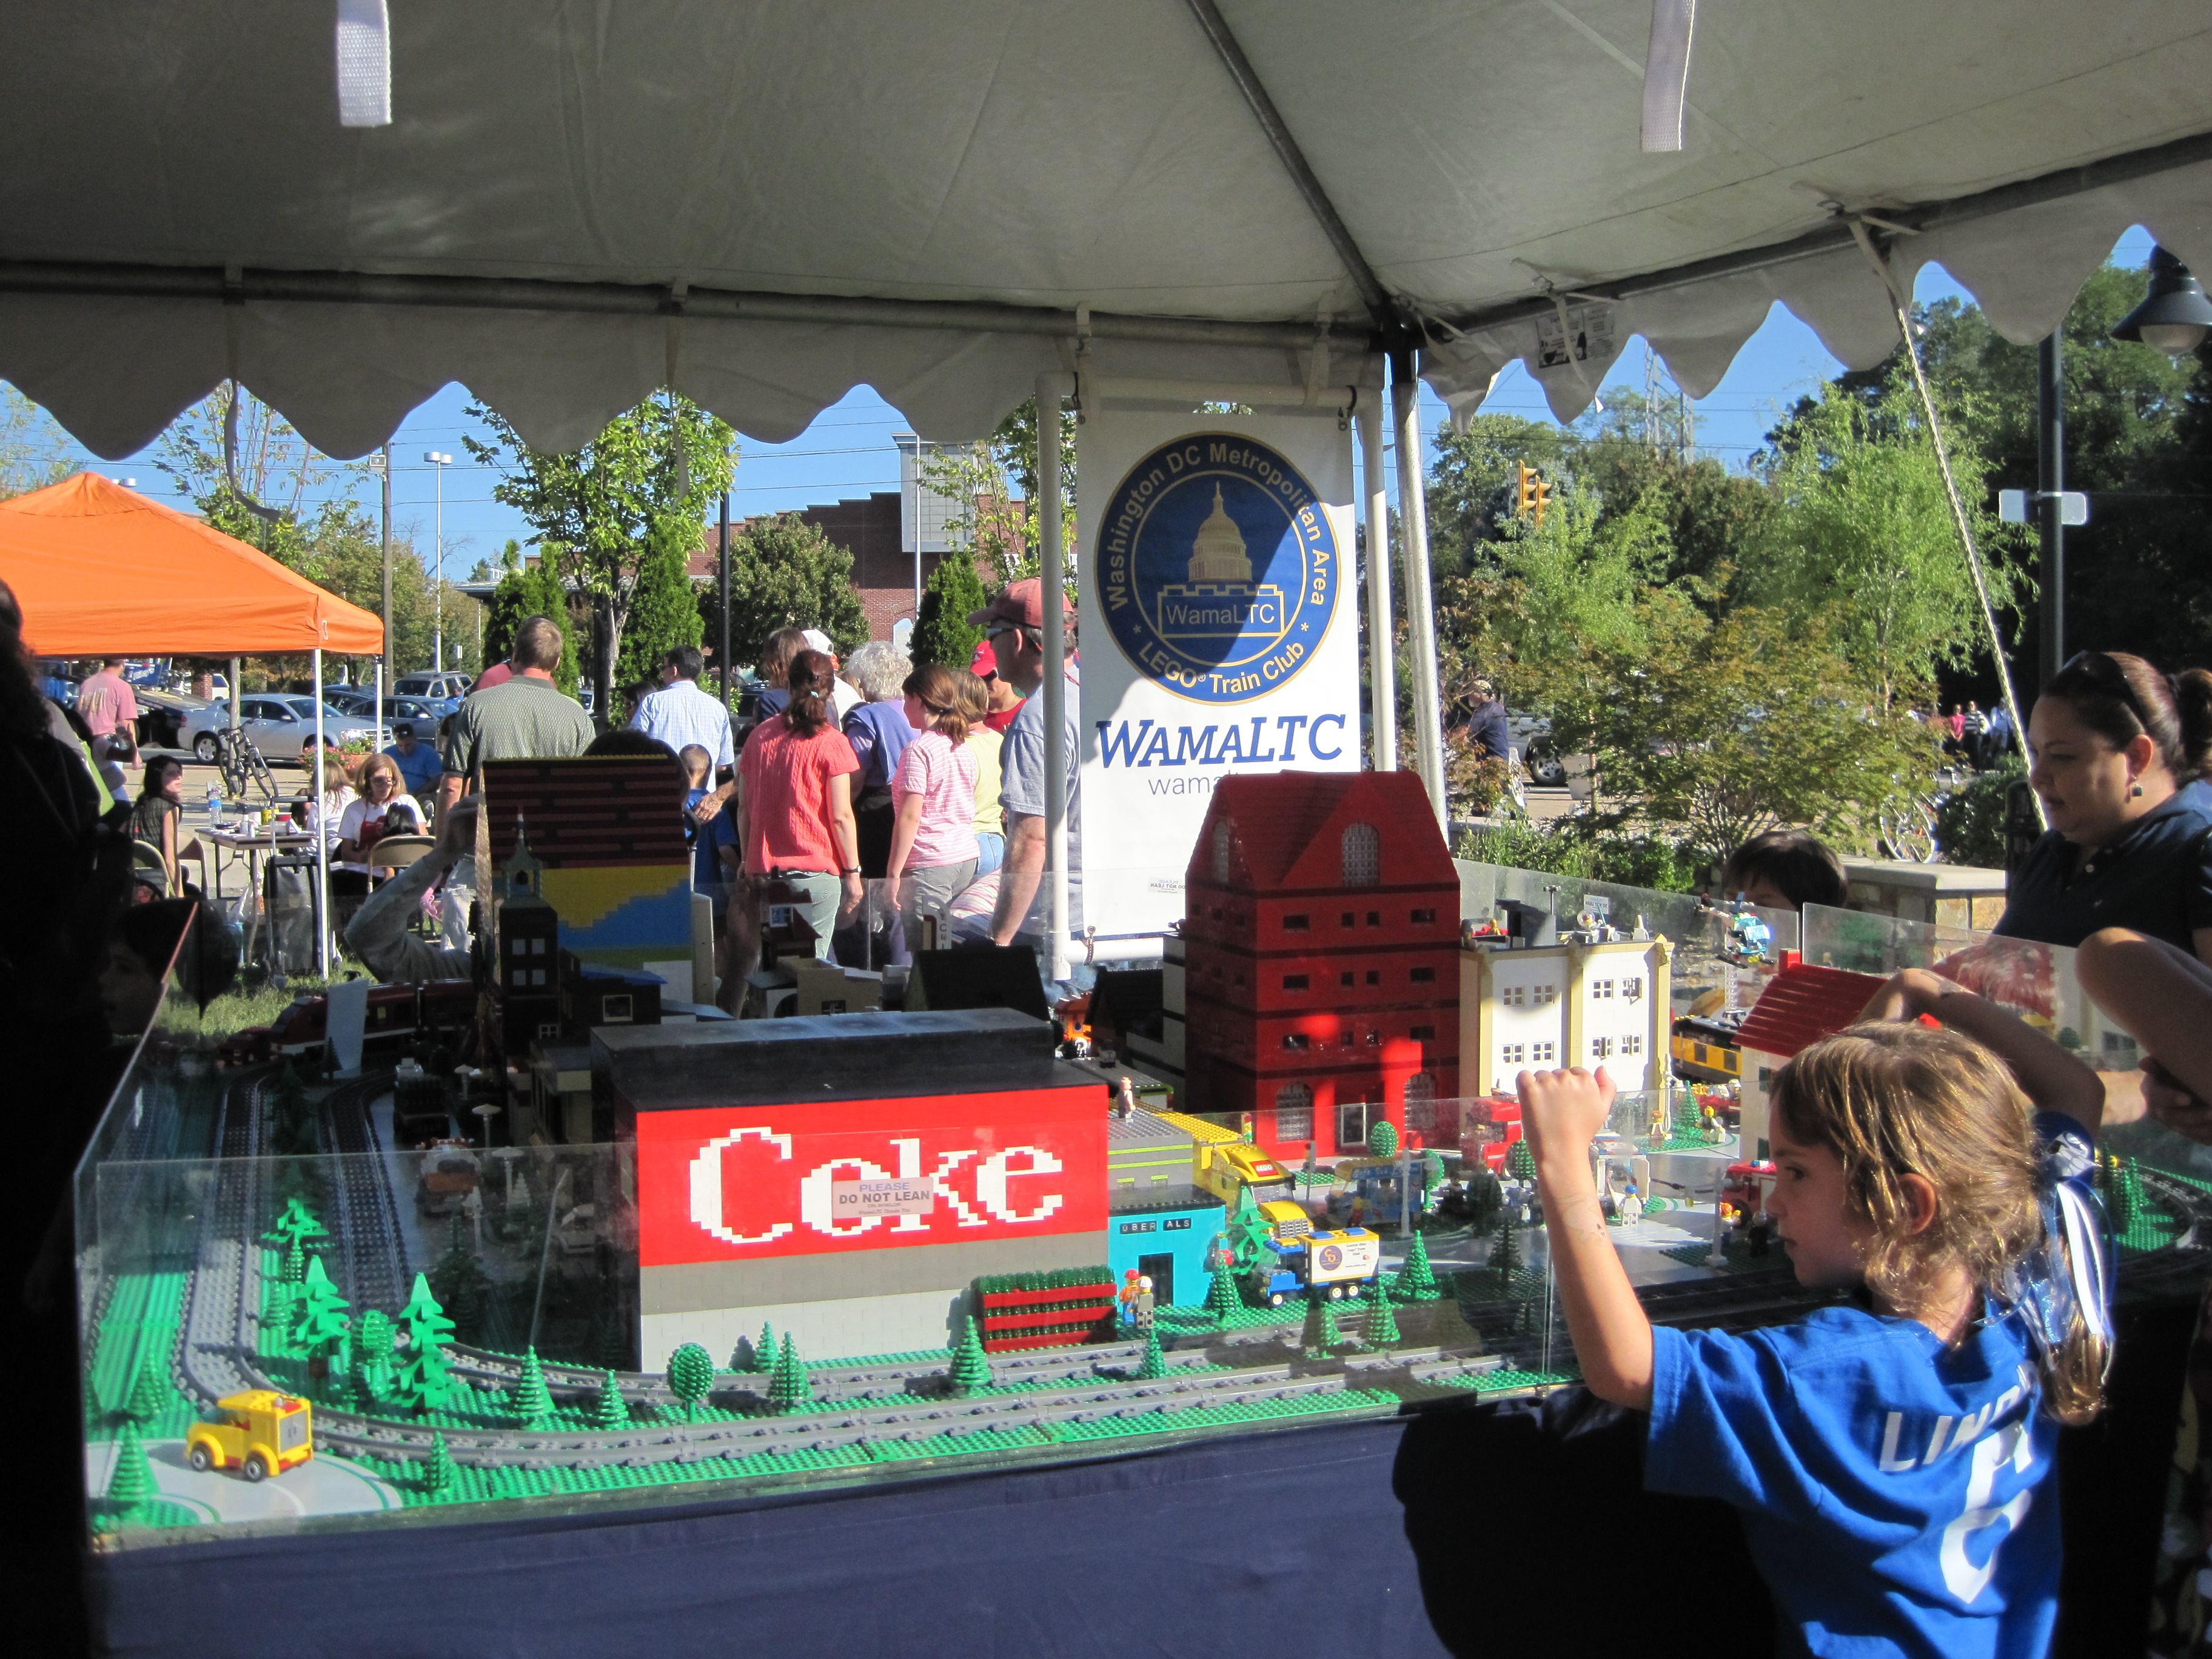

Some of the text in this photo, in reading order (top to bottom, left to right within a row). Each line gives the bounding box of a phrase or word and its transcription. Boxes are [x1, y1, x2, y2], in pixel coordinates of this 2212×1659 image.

[1106, 443, 1331, 611] Washington DC Metropolitan Area
[1165, 604, 1276, 625] WamaLTC
[1208, 672, 1262, 694] Train
[1262, 640, 1305, 680] Club
[1256, 1164, 1274, 1172] LEGO
[689, 1125, 1064, 1245] Coke
[859, 1182, 910, 1192] PLEASE
[839, 1190, 930, 1204] DO NOT LEAN
[1167, 1219, 1190, 1228] ALS
